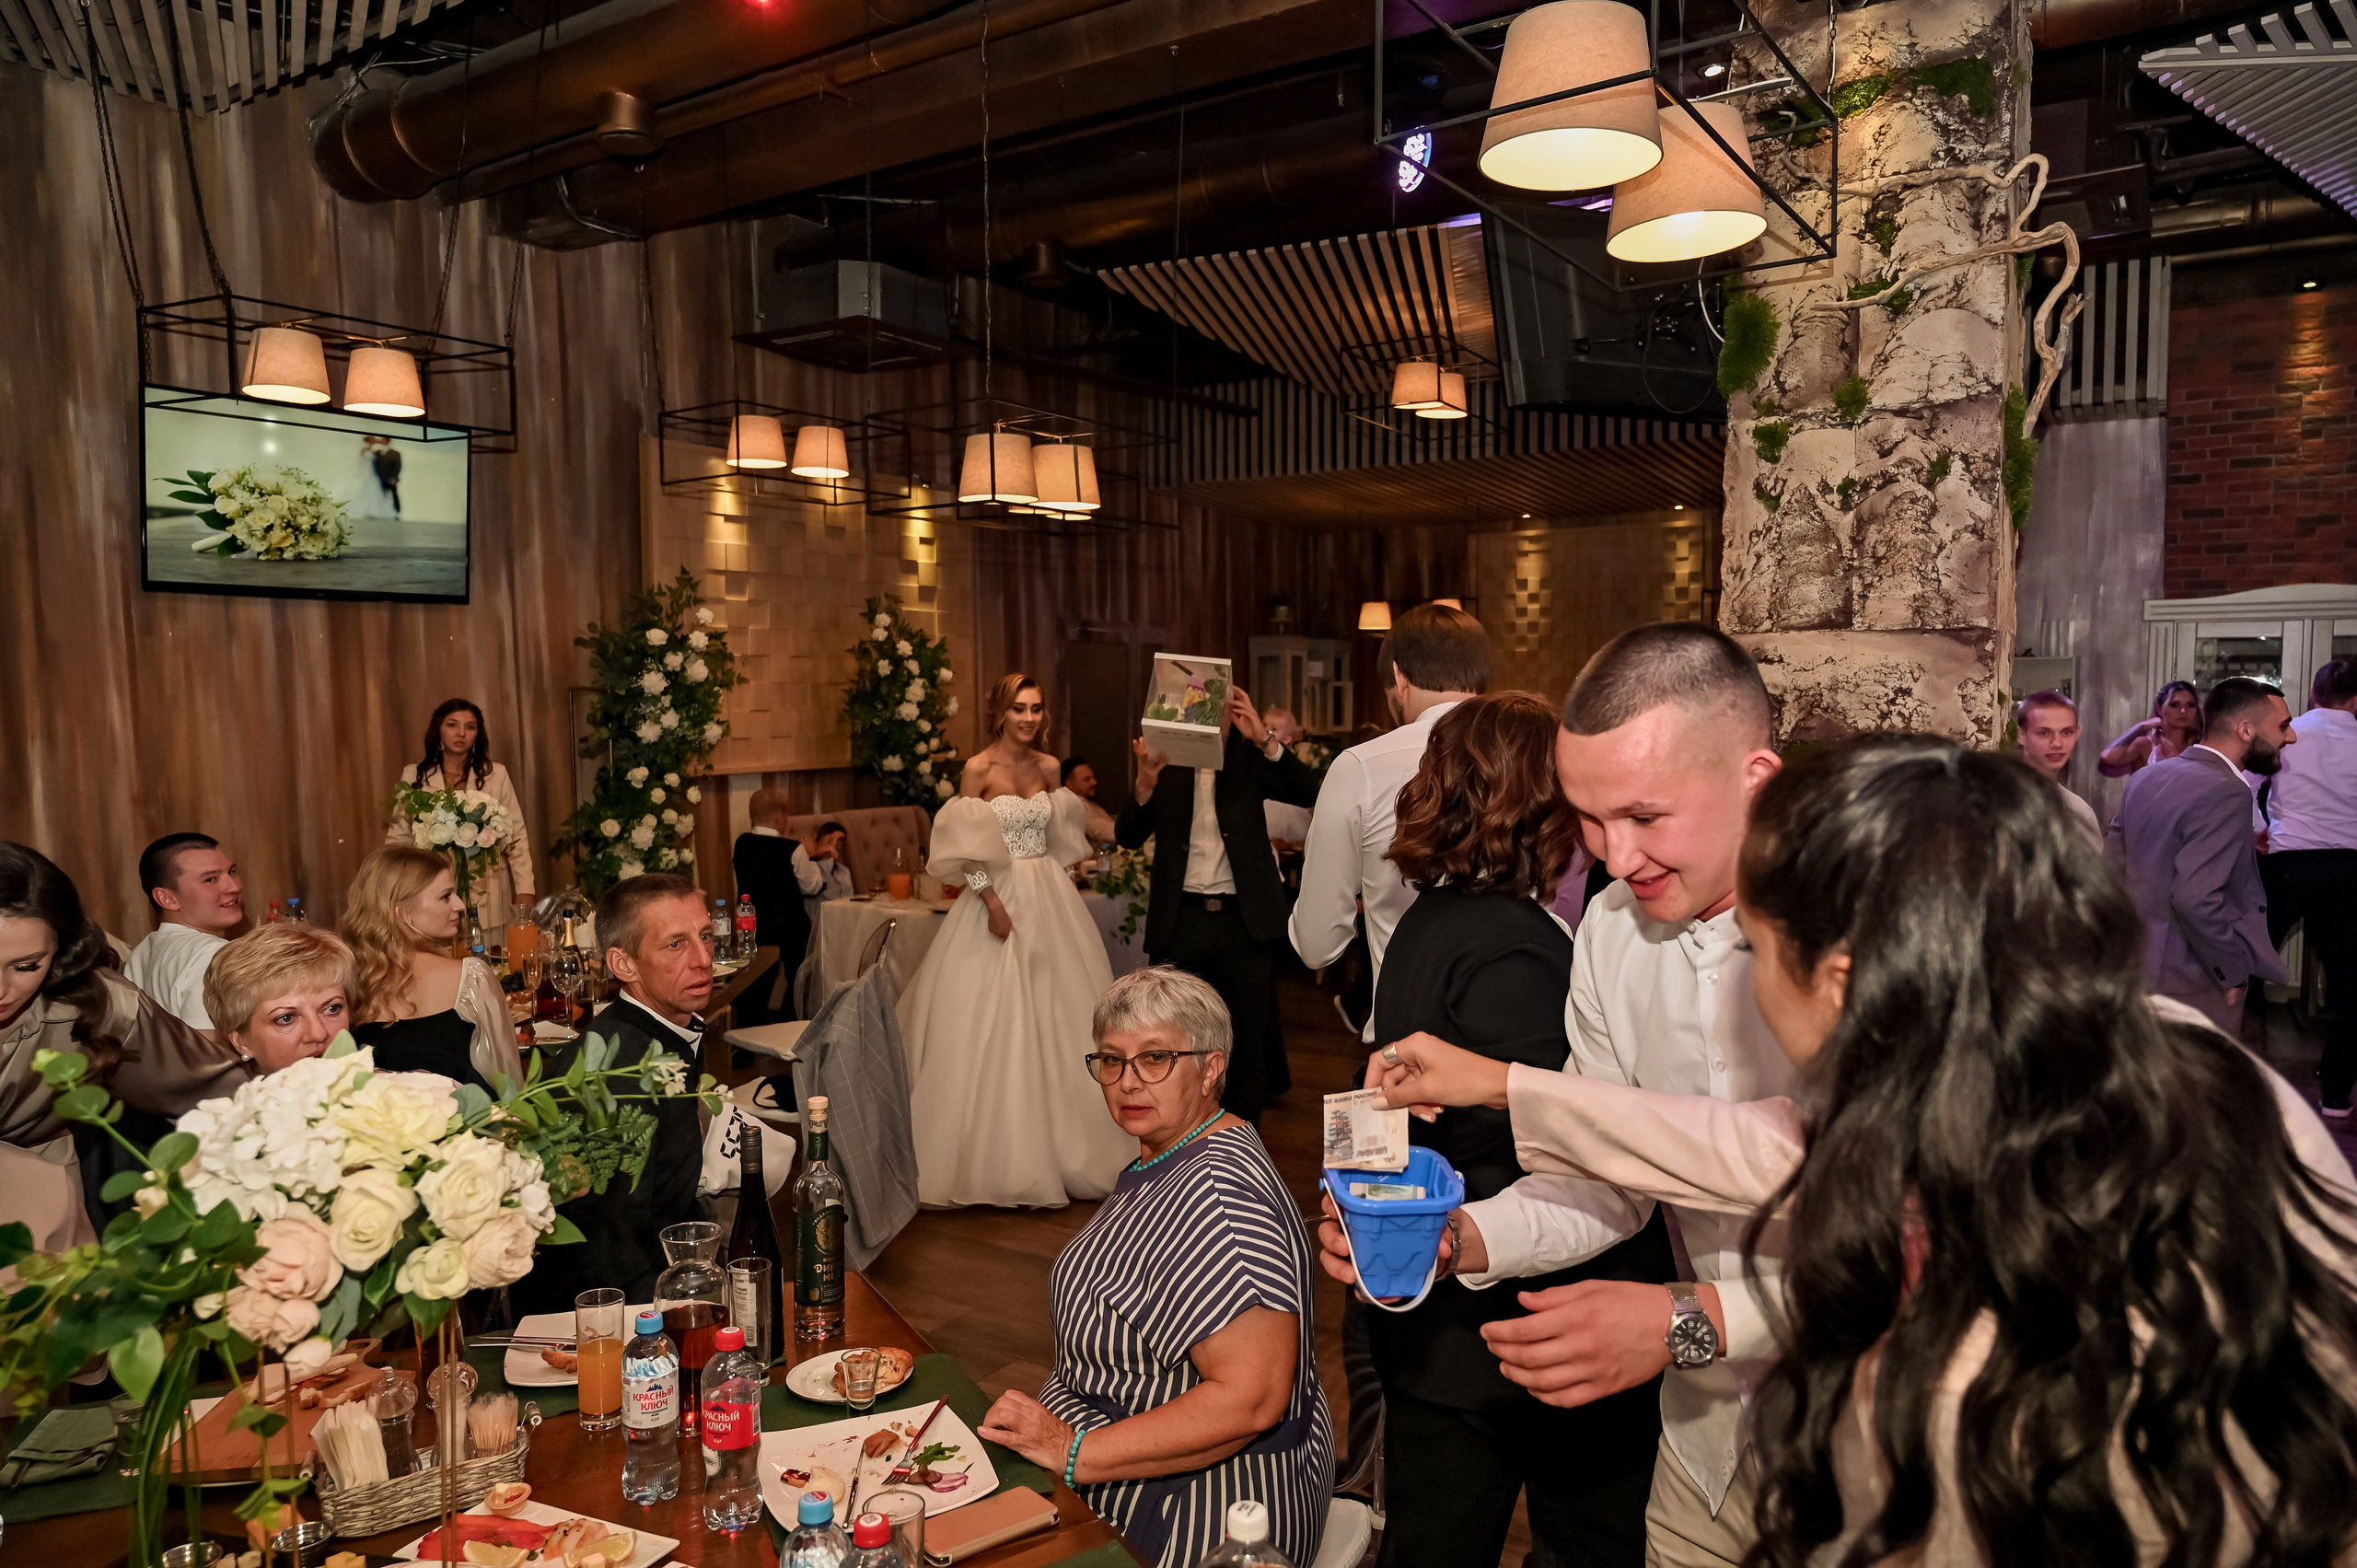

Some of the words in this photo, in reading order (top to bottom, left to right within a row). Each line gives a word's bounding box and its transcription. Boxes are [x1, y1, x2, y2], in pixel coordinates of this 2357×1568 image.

[633, 1384, 674, 1401] КРАСНЫЙ
[641, 1398, 668, 1411] КЛЮЧ
[706, 1421, 732, 1431] КЛЮЧ
